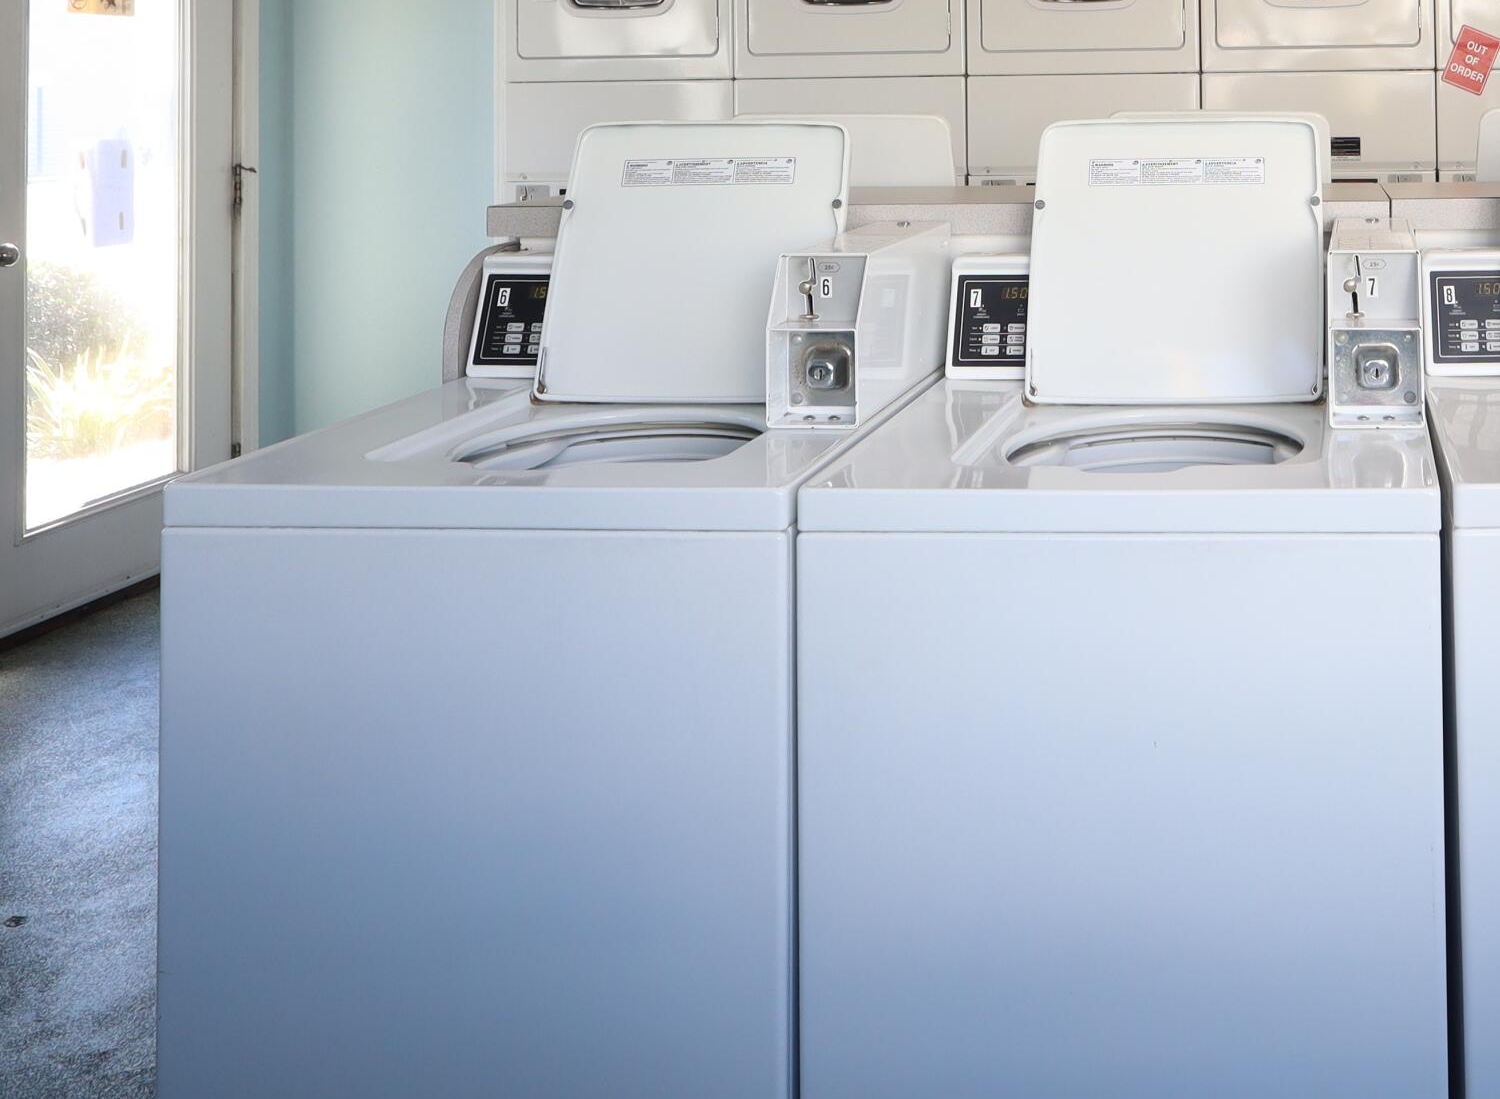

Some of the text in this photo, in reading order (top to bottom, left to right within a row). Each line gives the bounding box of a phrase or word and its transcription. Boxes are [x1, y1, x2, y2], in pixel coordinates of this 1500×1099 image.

[1466, 41, 1488, 55] OUT
[1465, 54, 1479, 66] OF
[1450, 63, 1485, 83] ORDER
[822, 279, 830, 296] 6
[1368, 278, 1375, 295] 7
[500, 290, 507, 304] 6
[973, 291, 979, 306] 7
[1446, 288, 1452, 302] 8
